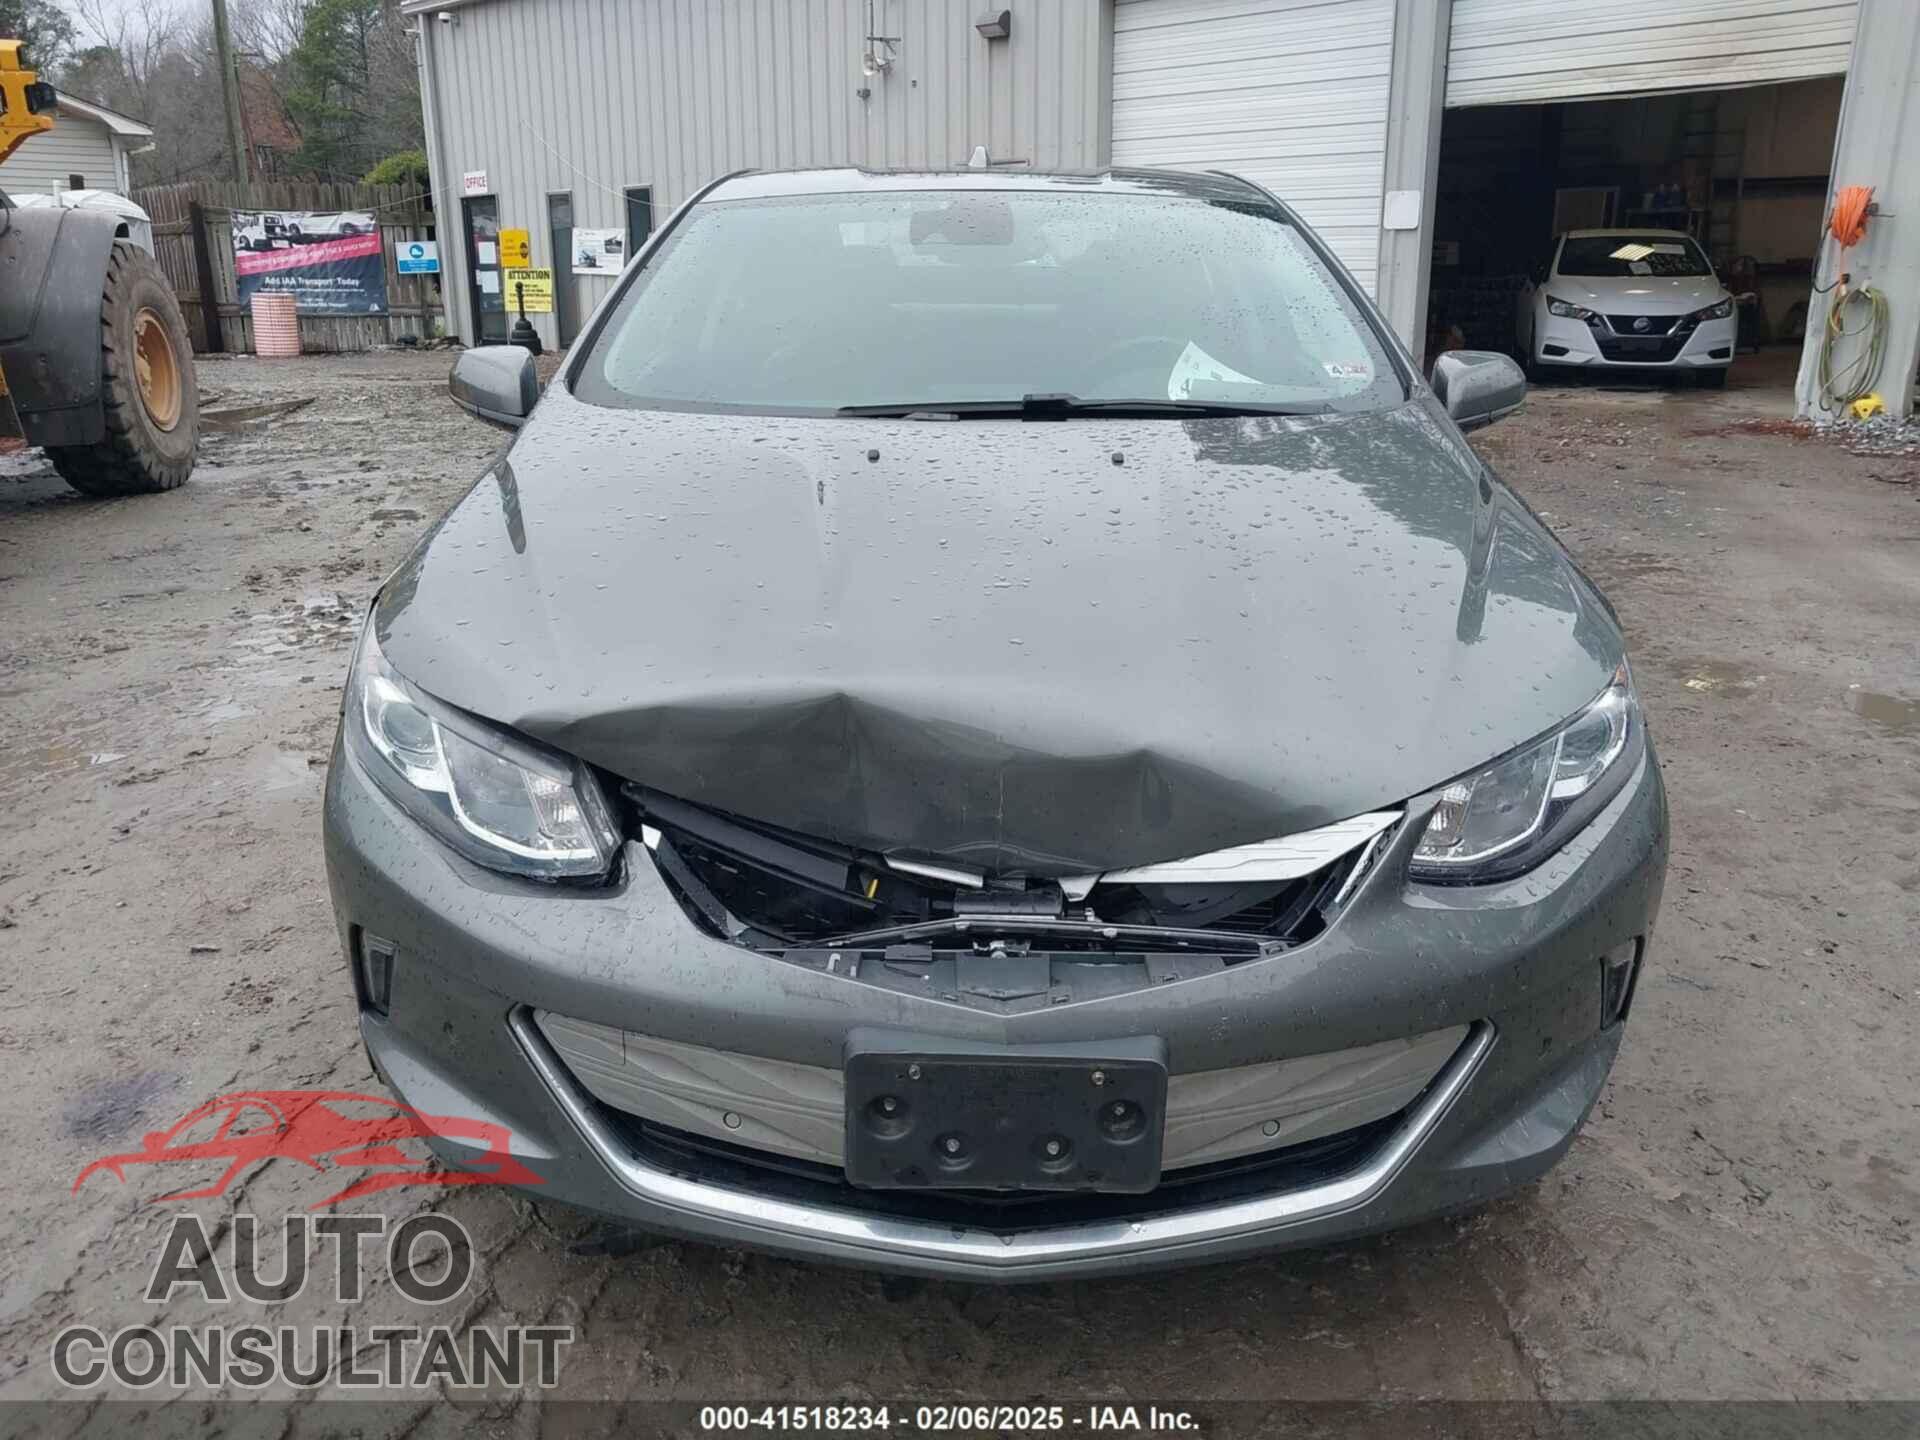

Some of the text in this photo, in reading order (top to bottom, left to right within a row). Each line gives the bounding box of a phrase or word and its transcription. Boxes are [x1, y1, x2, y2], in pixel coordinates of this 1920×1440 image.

[464, 176, 486, 189] OFFICE
[508, 270, 550, 280] ATTENTION
[298, 276, 333, 287] Transport
[336, 276, 359, 287] Today
